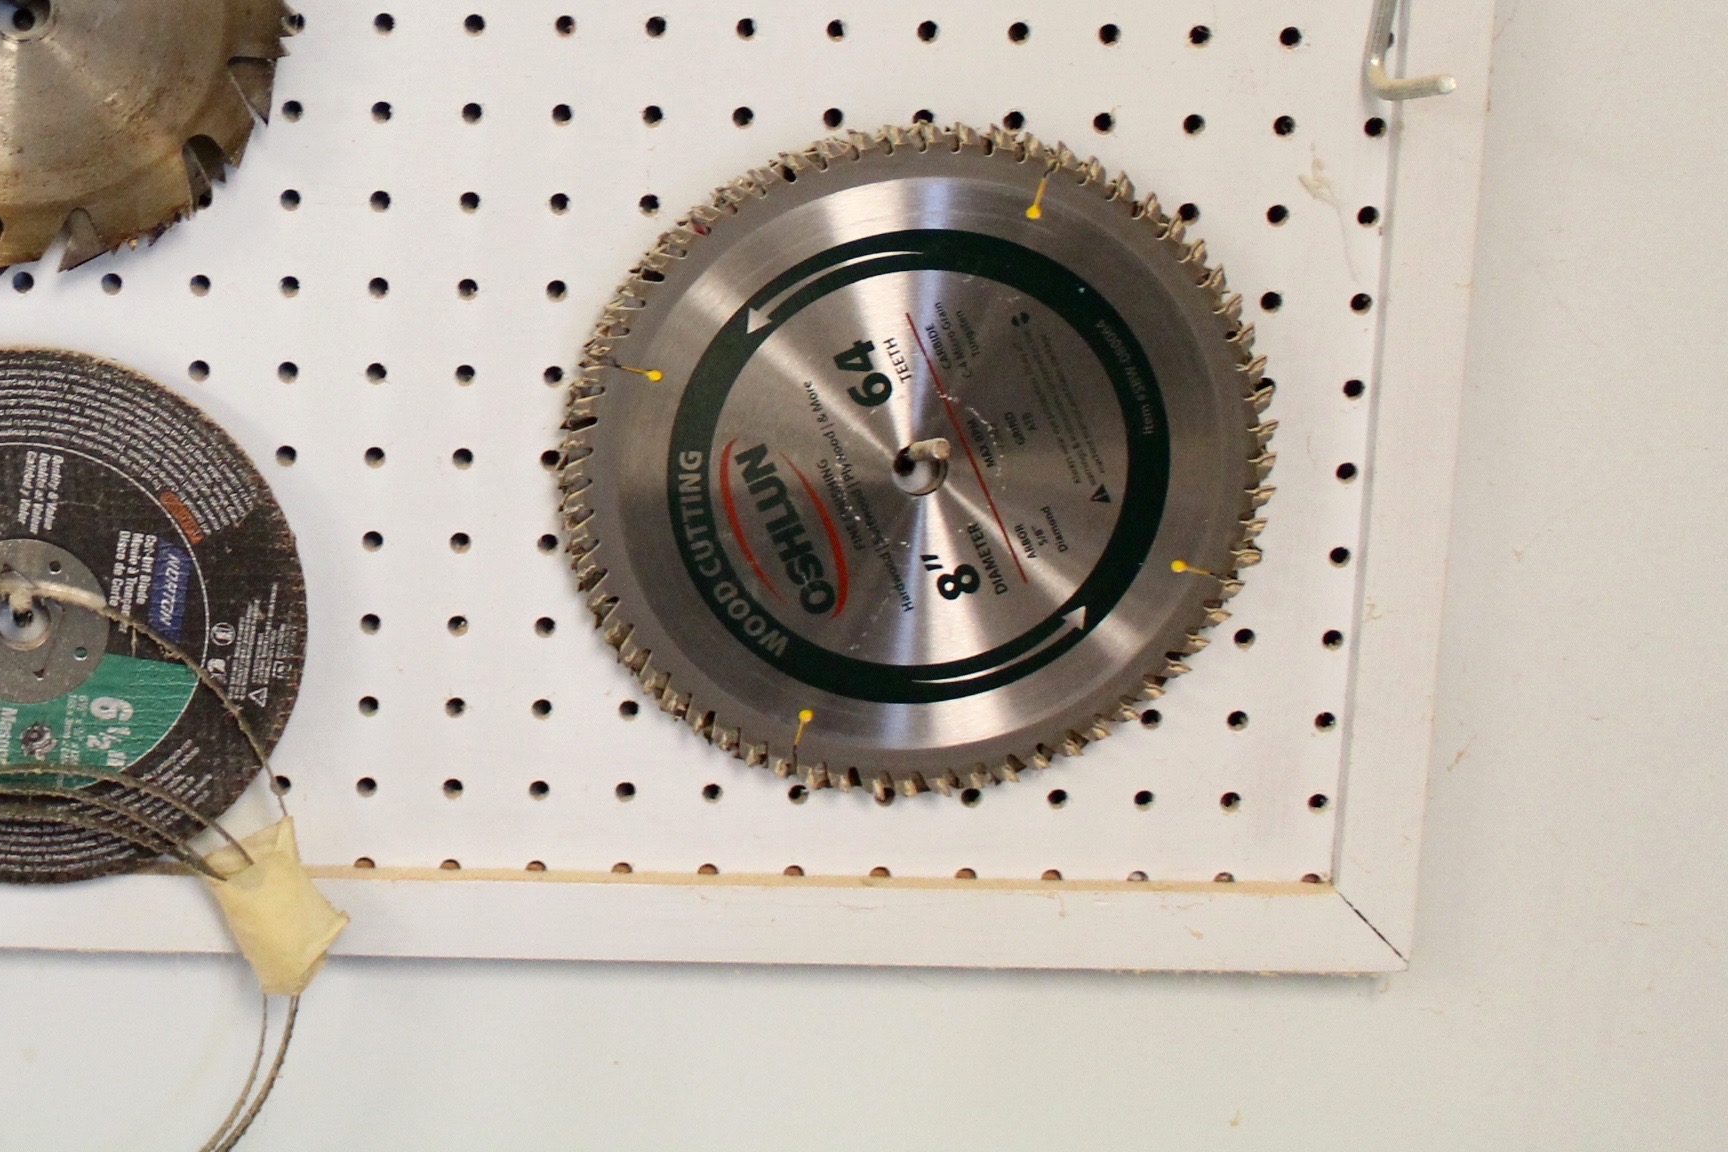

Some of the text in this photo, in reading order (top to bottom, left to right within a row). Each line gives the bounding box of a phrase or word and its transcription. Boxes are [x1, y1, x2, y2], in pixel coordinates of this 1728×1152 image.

[925, 323, 952, 370] CARBIDE
[955, 309, 981, 358] Tungsten
[832, 339, 892, 408] 64
[883, 336, 914, 383] TEETH
[802, 381, 823, 412] More
[815, 412, 828, 423] &
[1136, 402, 1157, 436] Item
[1003, 410, 1025, 446] GRIND
[21, 449, 38, 489] Calidad
[822, 429, 855, 483] Plywood
[977, 439, 994, 467] MAX
[16, 497, 31, 524] Valor
[42, 453, 65, 530] Quality & Value
[815, 457, 866, 551] FINE FINISHING
[28, 501, 44, 535] Valeur
[734, 442, 836, 615] OSHLUN
[1013, 522, 1038, 558] ARBOR
[1039, 505, 1068, 553] Diamond
[115, 529, 131, 560] Disco
[677, 450, 790, 658] WOOD CUTTING
[919, 536, 985, 600] 8"
[965, 522, 1008, 595] DIAMETER
[107, 576, 124, 607] Corte
[112, 561, 126, 576] de
[134, 573, 152, 604] Blade
[159, 552, 180, 626] NORTON
[878, 550, 914, 612] Hardwood
